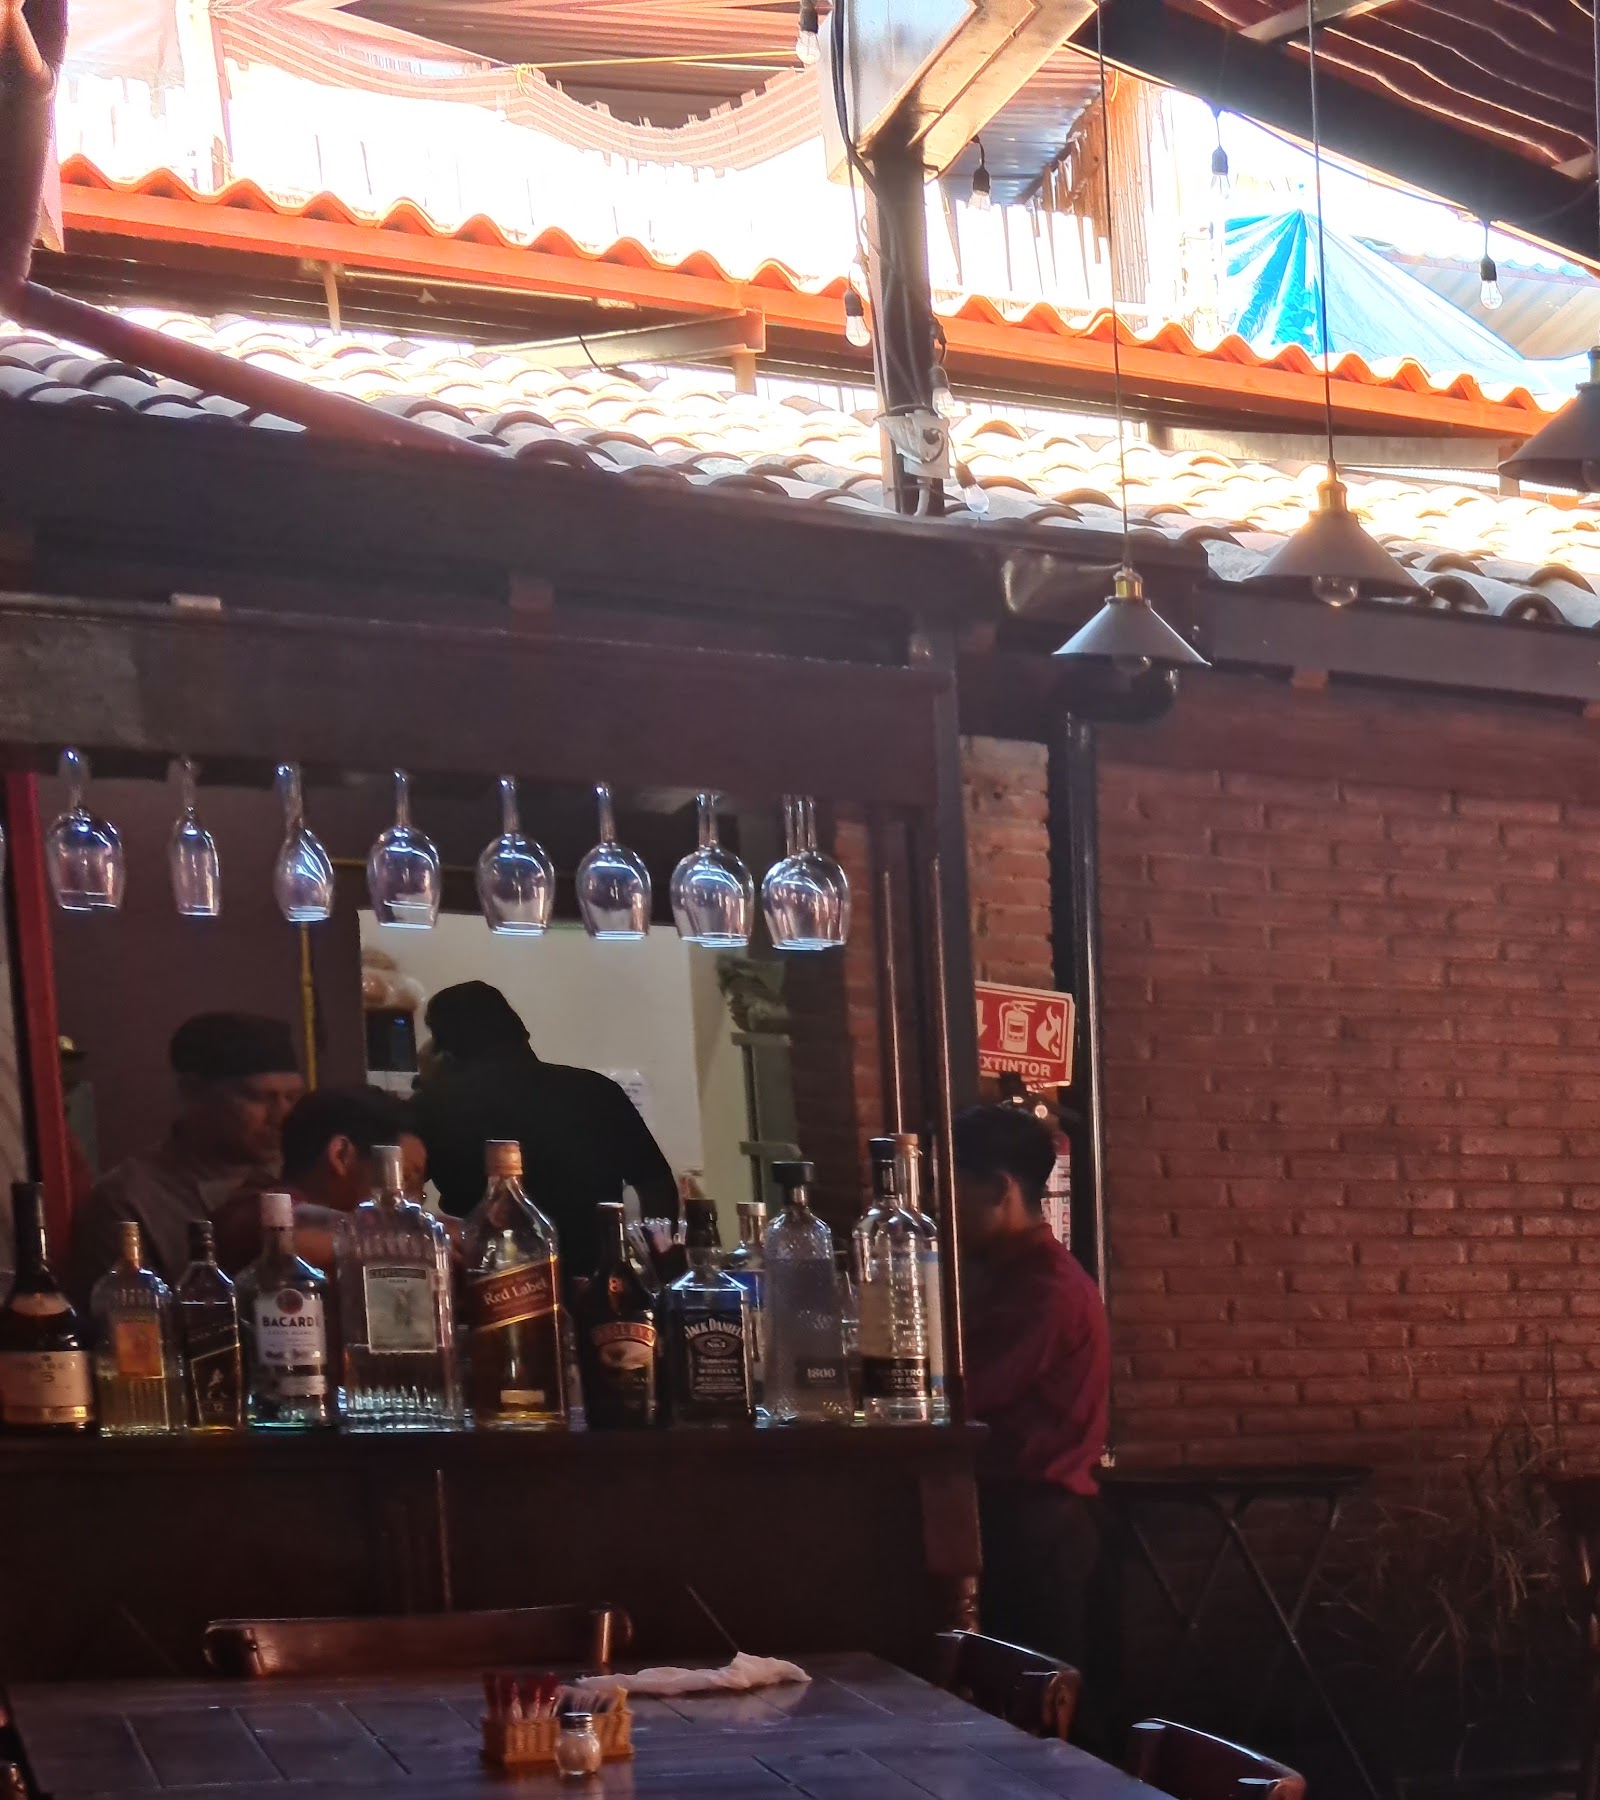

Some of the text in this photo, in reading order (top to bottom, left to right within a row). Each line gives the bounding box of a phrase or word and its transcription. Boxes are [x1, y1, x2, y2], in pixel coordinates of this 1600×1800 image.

[979, 1055, 1051, 1078] XTINTOR
[483, 1278, 549, 1306] Red Label
